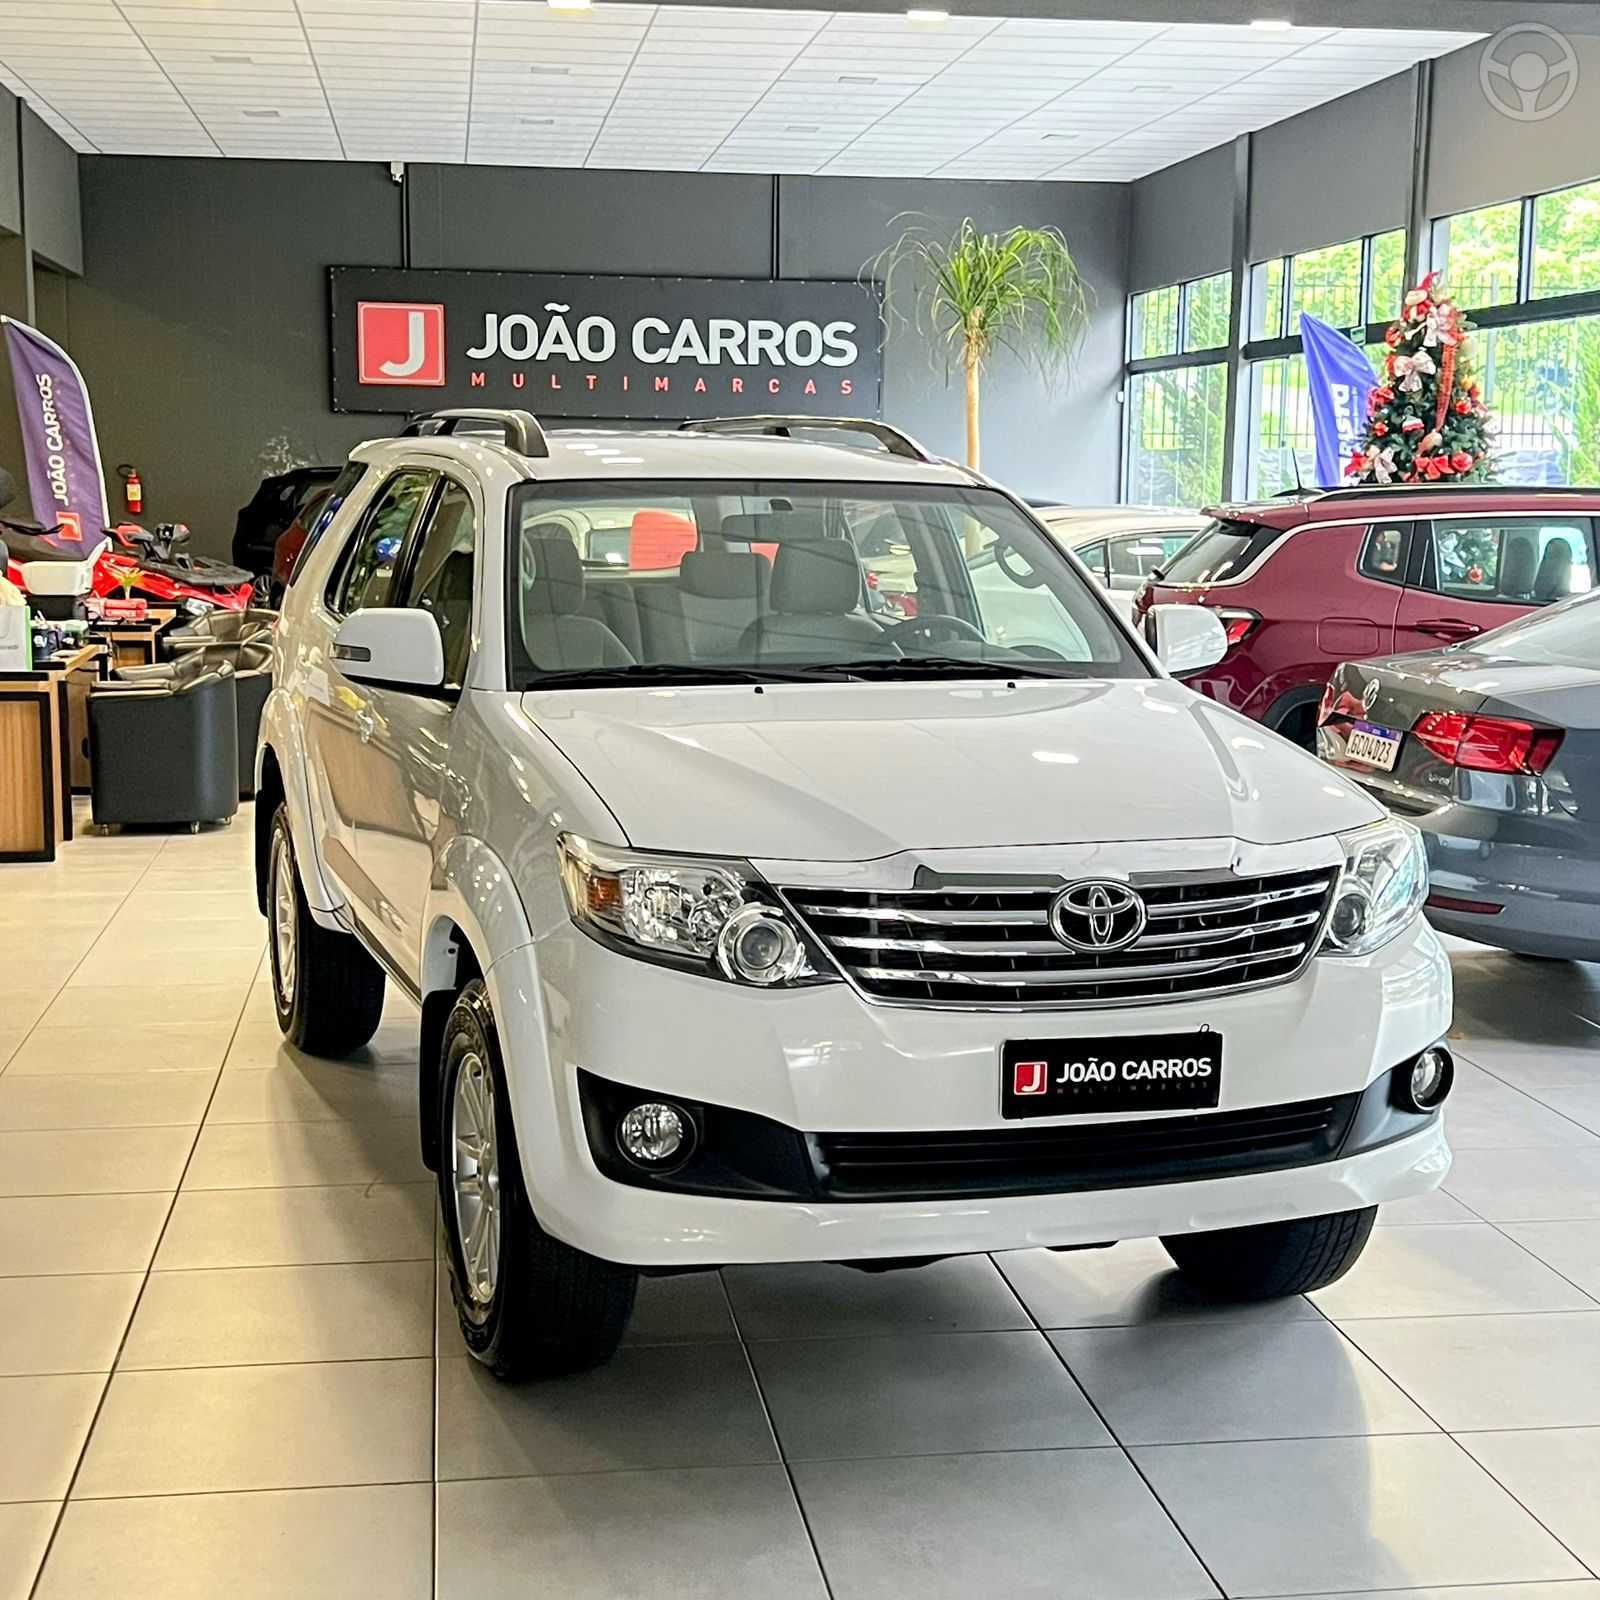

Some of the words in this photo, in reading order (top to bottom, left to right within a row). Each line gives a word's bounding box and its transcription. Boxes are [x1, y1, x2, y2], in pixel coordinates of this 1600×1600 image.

[378, 311, 425, 377] J
[466, 302, 616, 362] JOÃO
[631, 317, 858, 367] CARROS
[471, 372, 853, 395] MULTIMARCAS
[36, 374, 63, 452] CARROS
[47, 455, 69, 507] JOÃO
[1021, 1064, 1041, 1092] J
[1056, 1057, 1116, 1083] JOÃO
[1122, 1057, 1212, 1080] CARROS
